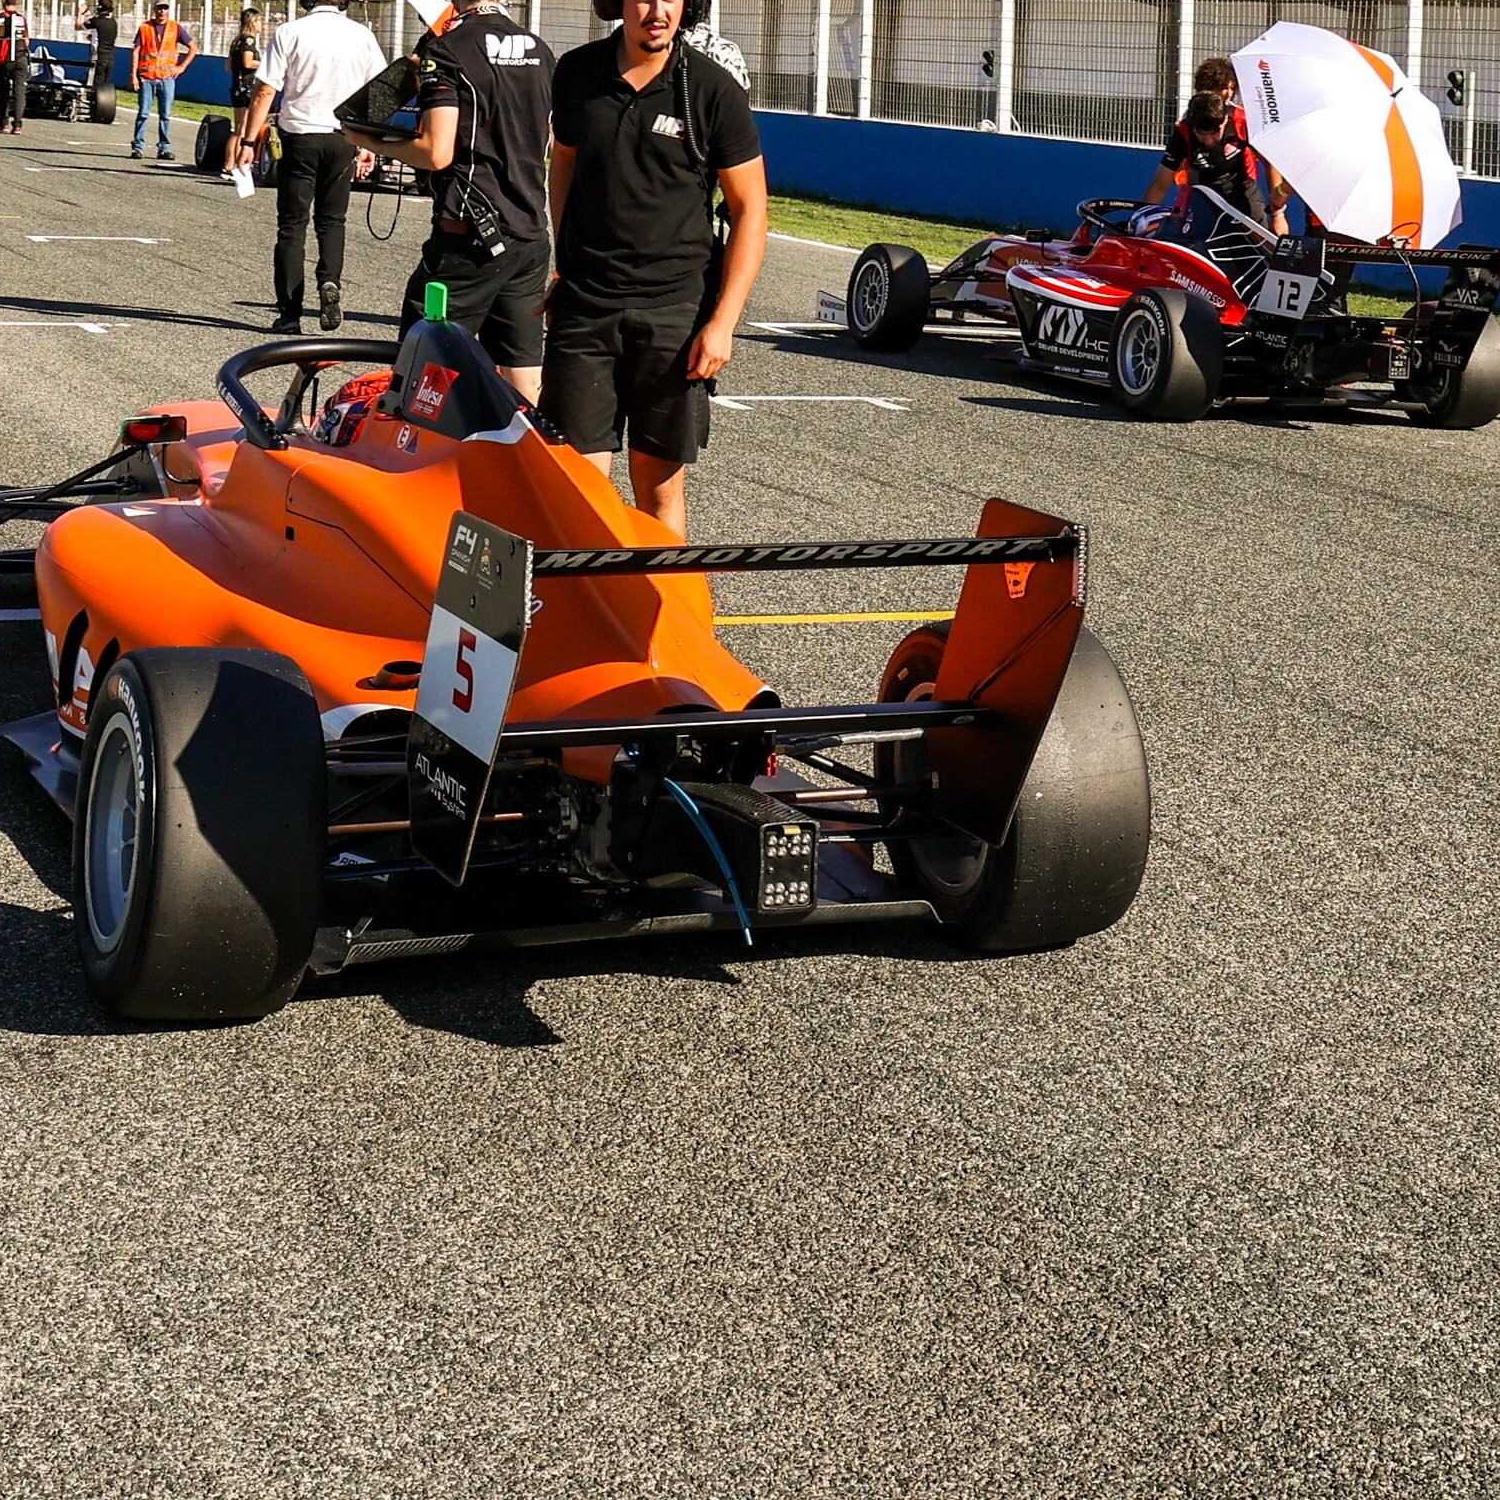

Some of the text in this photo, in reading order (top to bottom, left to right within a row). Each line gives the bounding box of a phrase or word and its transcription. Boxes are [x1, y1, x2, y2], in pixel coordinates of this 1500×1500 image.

[485, 32, 537, 59] MP
[651, 113, 685, 137] MP
[1279, 238, 1295, 250] F4
[1439, 252, 1493, 262] RACING
[1168, 269, 1213, 301] SAMSUNG
[1276, 279, 1301, 312] 12
[1456, 287, 1480, 305] VAR
[1255, 330, 1288, 345] ATLANTIC
[1058, 344, 1105, 363] DEVELOPMENT
[415, 374, 444, 406] Intesa
[453, 524, 478, 556] F4
[536, 538, 1040, 569] MP MOTORSPORT
[452, 626, 477, 714] 5
[414, 752, 467, 808] ATLANTIC
